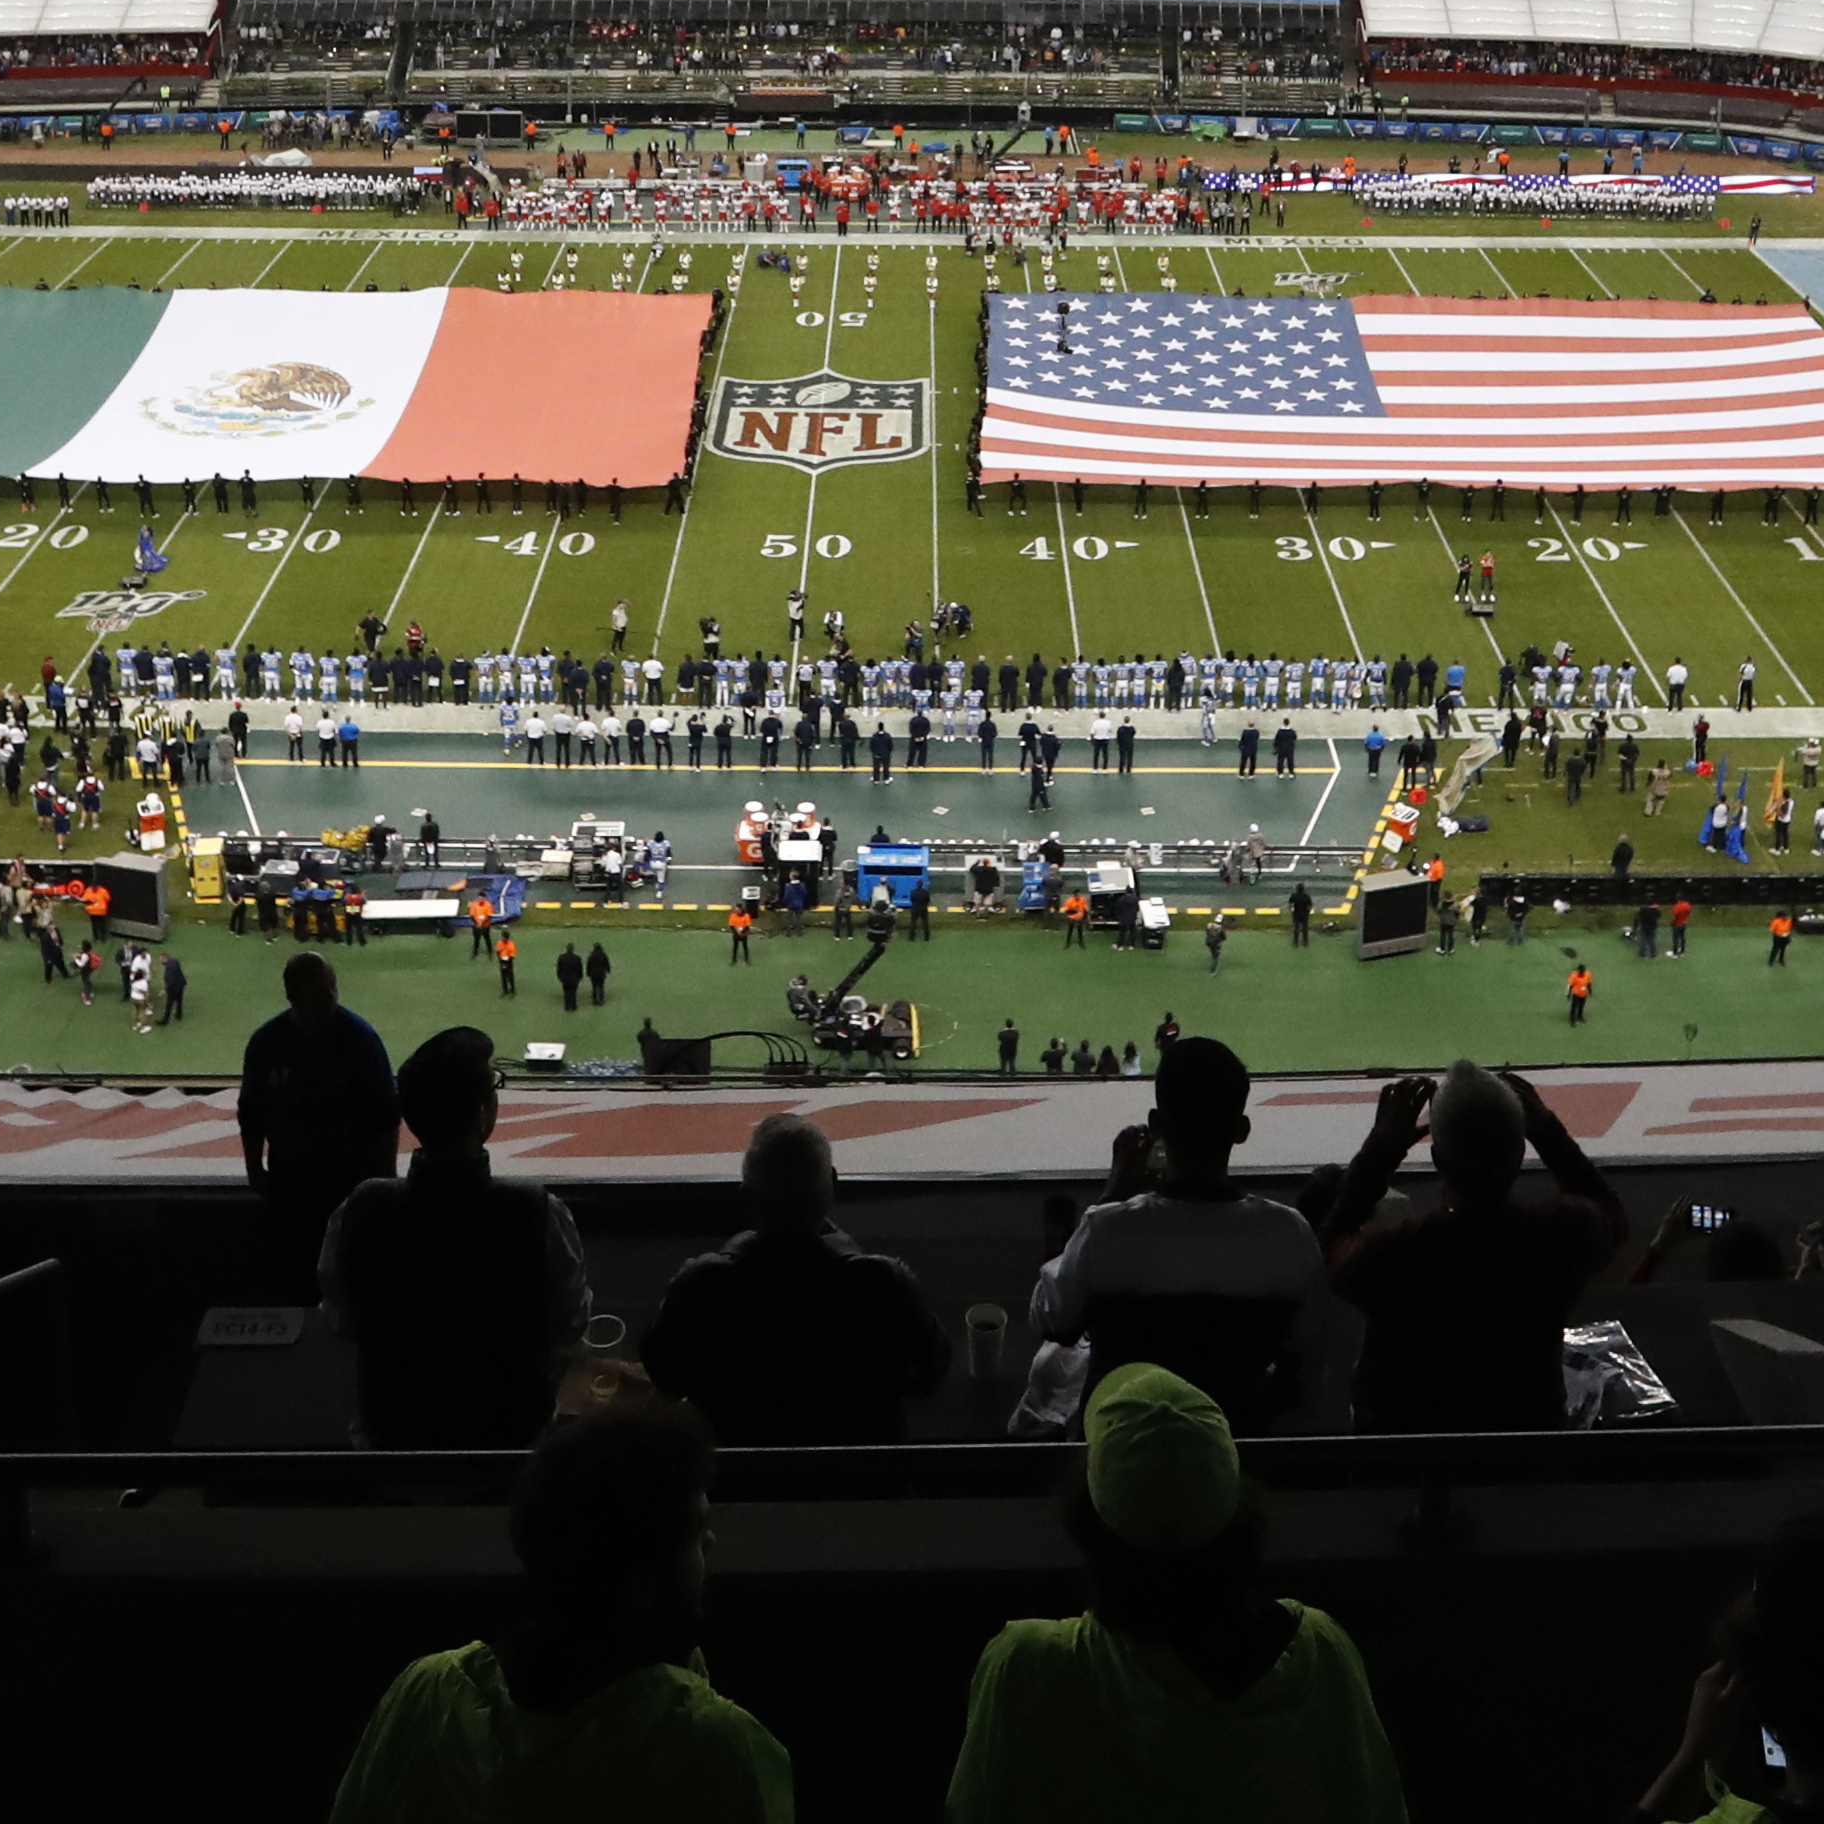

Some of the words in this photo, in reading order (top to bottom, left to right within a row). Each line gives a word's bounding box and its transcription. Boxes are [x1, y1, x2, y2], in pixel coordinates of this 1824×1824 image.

[733, 411, 903, 457] NFL
[246, 526, 342, 555] 30
[504, 530, 597, 557] 40
[760, 533, 853, 559] 50
[1019, 535, 1109, 561] 40
[1275, 535, 1367, 562] 30
[1527, 536, 1621, 562] 20
[1416, 713, 1648, 733] MEICO
